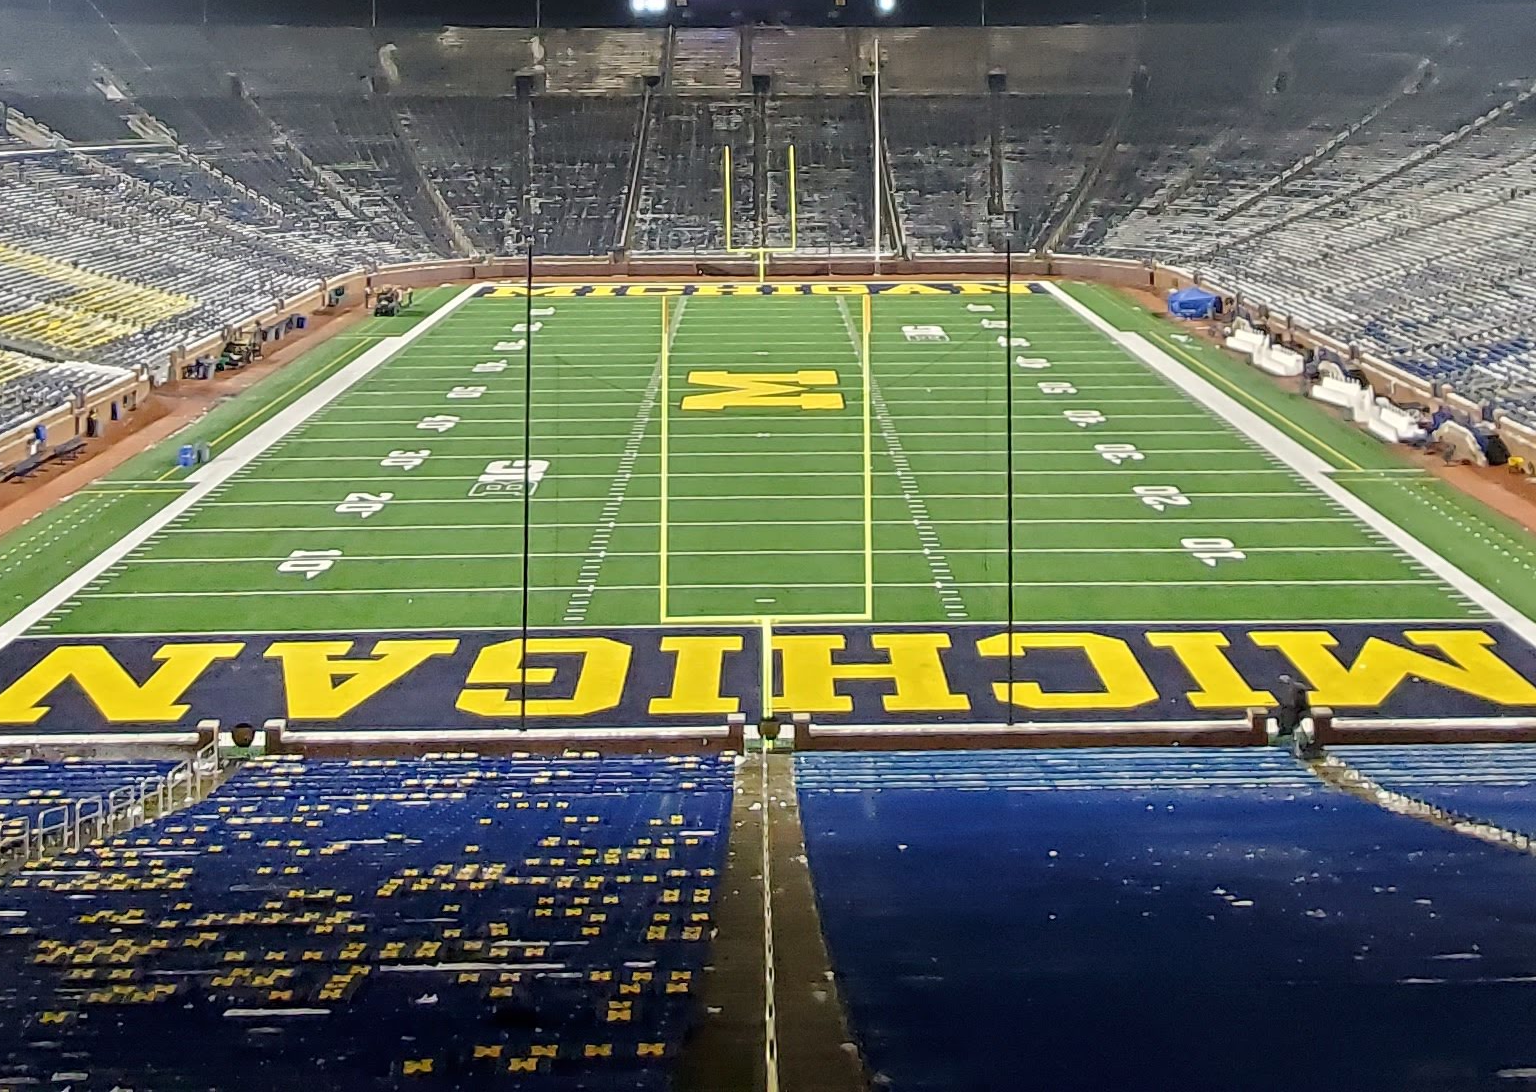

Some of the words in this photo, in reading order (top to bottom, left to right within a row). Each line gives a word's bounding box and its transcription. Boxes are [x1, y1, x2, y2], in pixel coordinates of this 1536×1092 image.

[487, 285, 1032, 295] MICHIGAN
[681, 370, 845, 411] M
[380, 449, 432, 467] 30
[1093, 444, 1146, 460] 30
[334, 491, 395, 514] 20
[1131, 485, 1191, 506] 20
[1180, 537, 1246, 561] 10
[276, 549, 343, 573] 10
